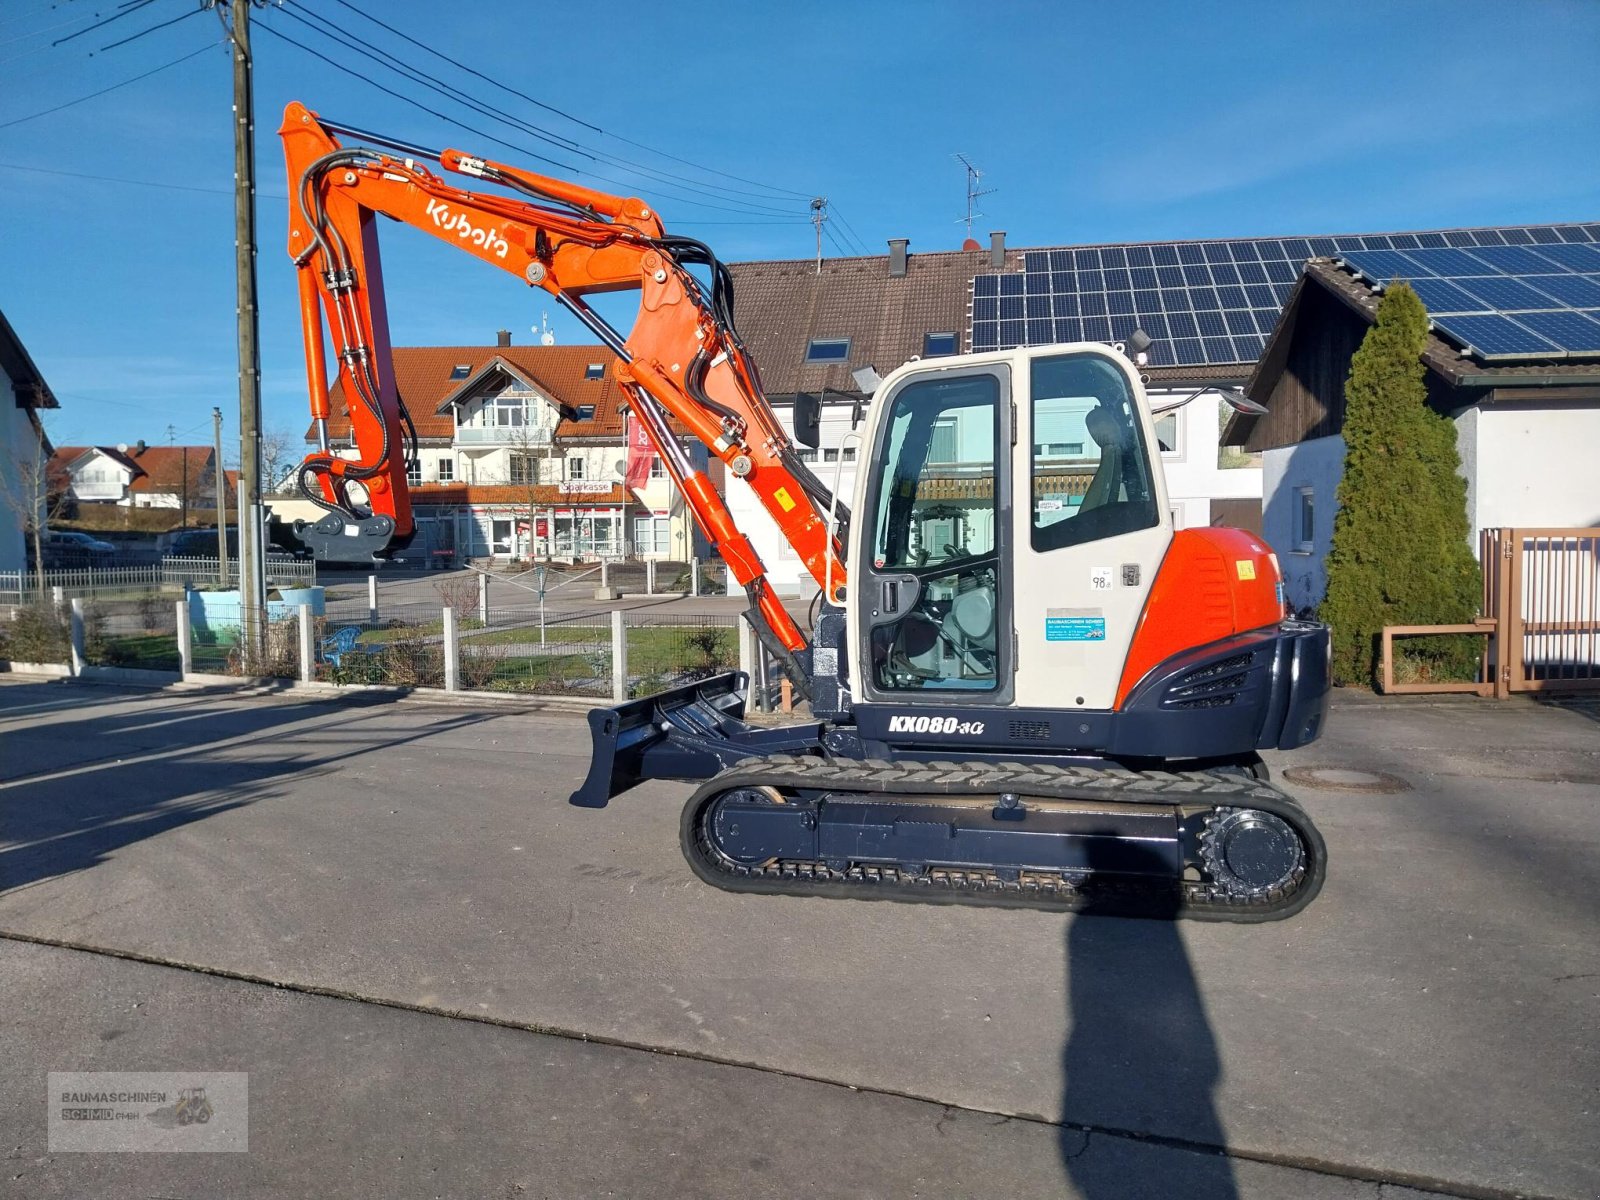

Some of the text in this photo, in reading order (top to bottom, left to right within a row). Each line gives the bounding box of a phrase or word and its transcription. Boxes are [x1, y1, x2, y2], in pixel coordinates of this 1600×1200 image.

[425, 198, 509, 259] Kubota
[562, 483, 609, 492] Sparkasse
[1092, 577, 1106, 588] 98
